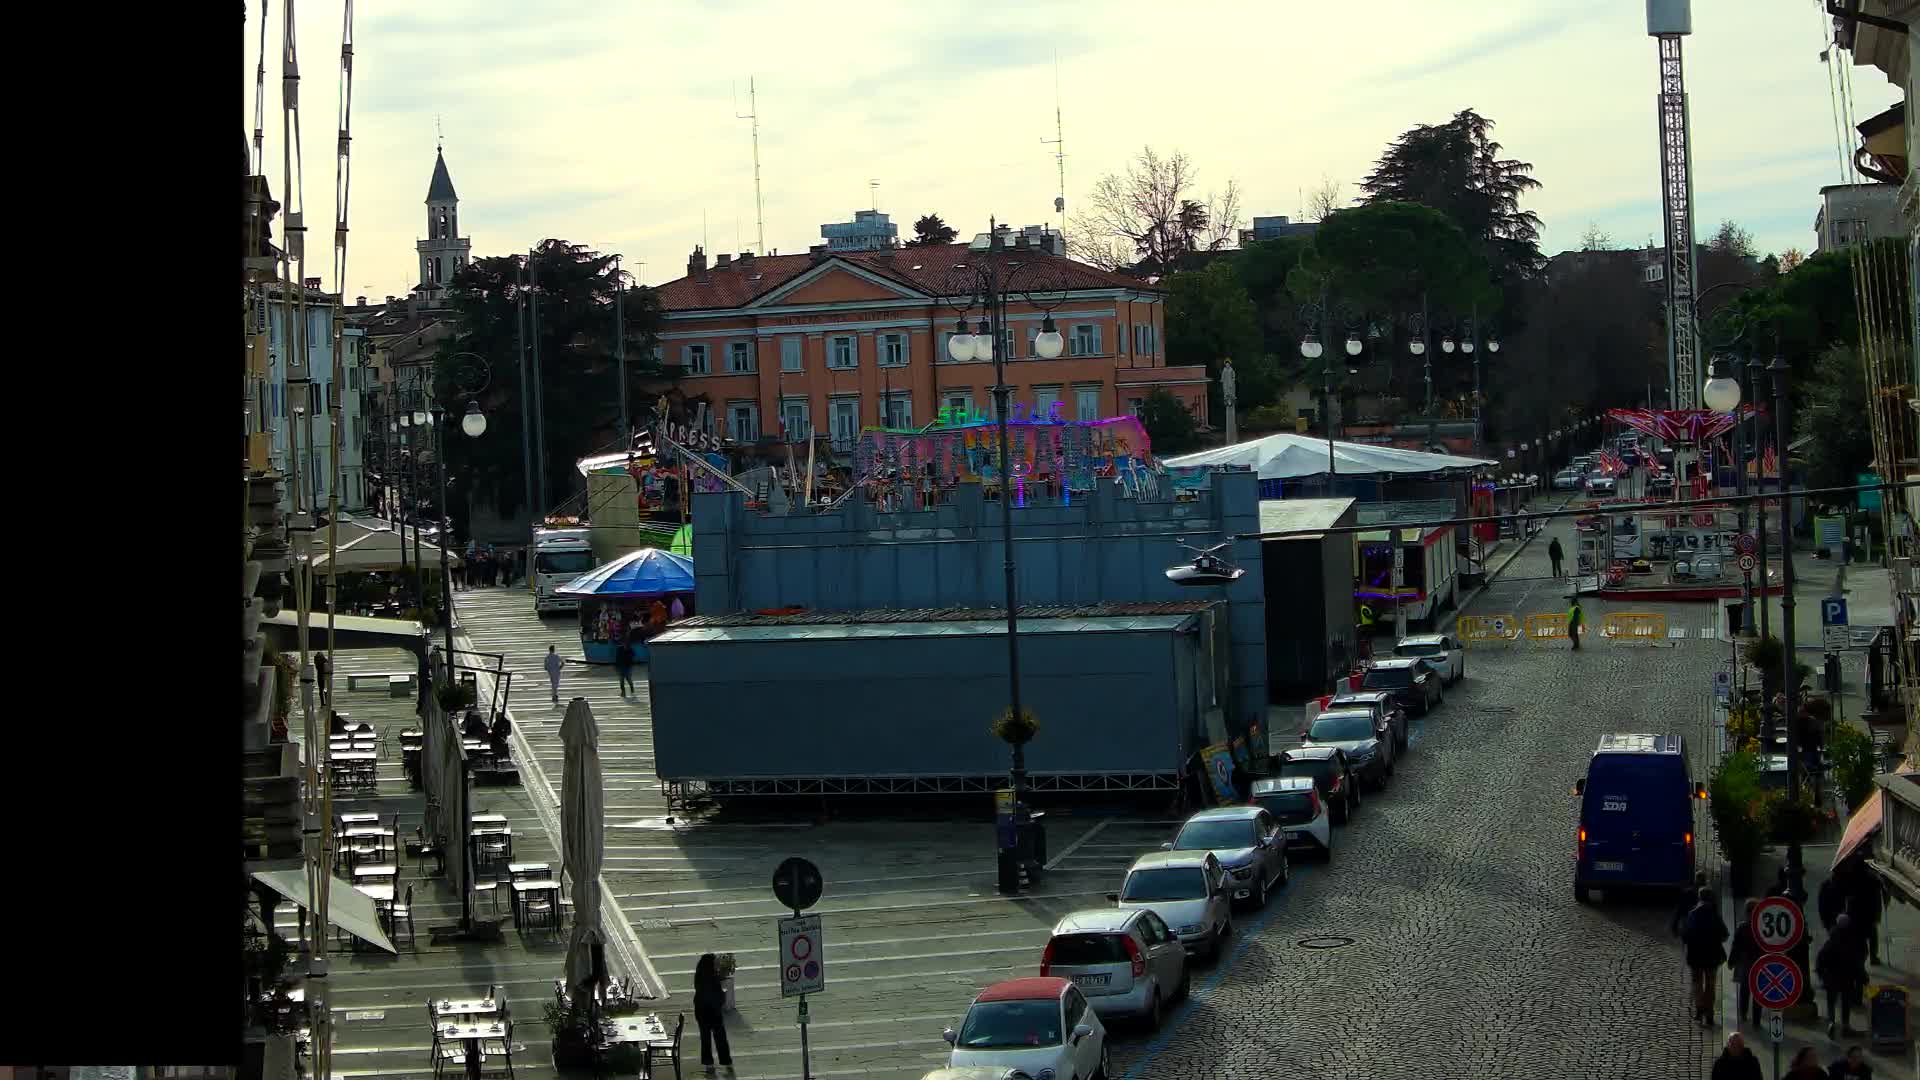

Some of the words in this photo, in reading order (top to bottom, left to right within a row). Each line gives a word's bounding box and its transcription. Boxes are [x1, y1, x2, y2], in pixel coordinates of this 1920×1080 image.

[1742, 557, 1752, 567] 20
[1825, 602, 1842, 622] P
[1762, 911, 1792, 938] 30
